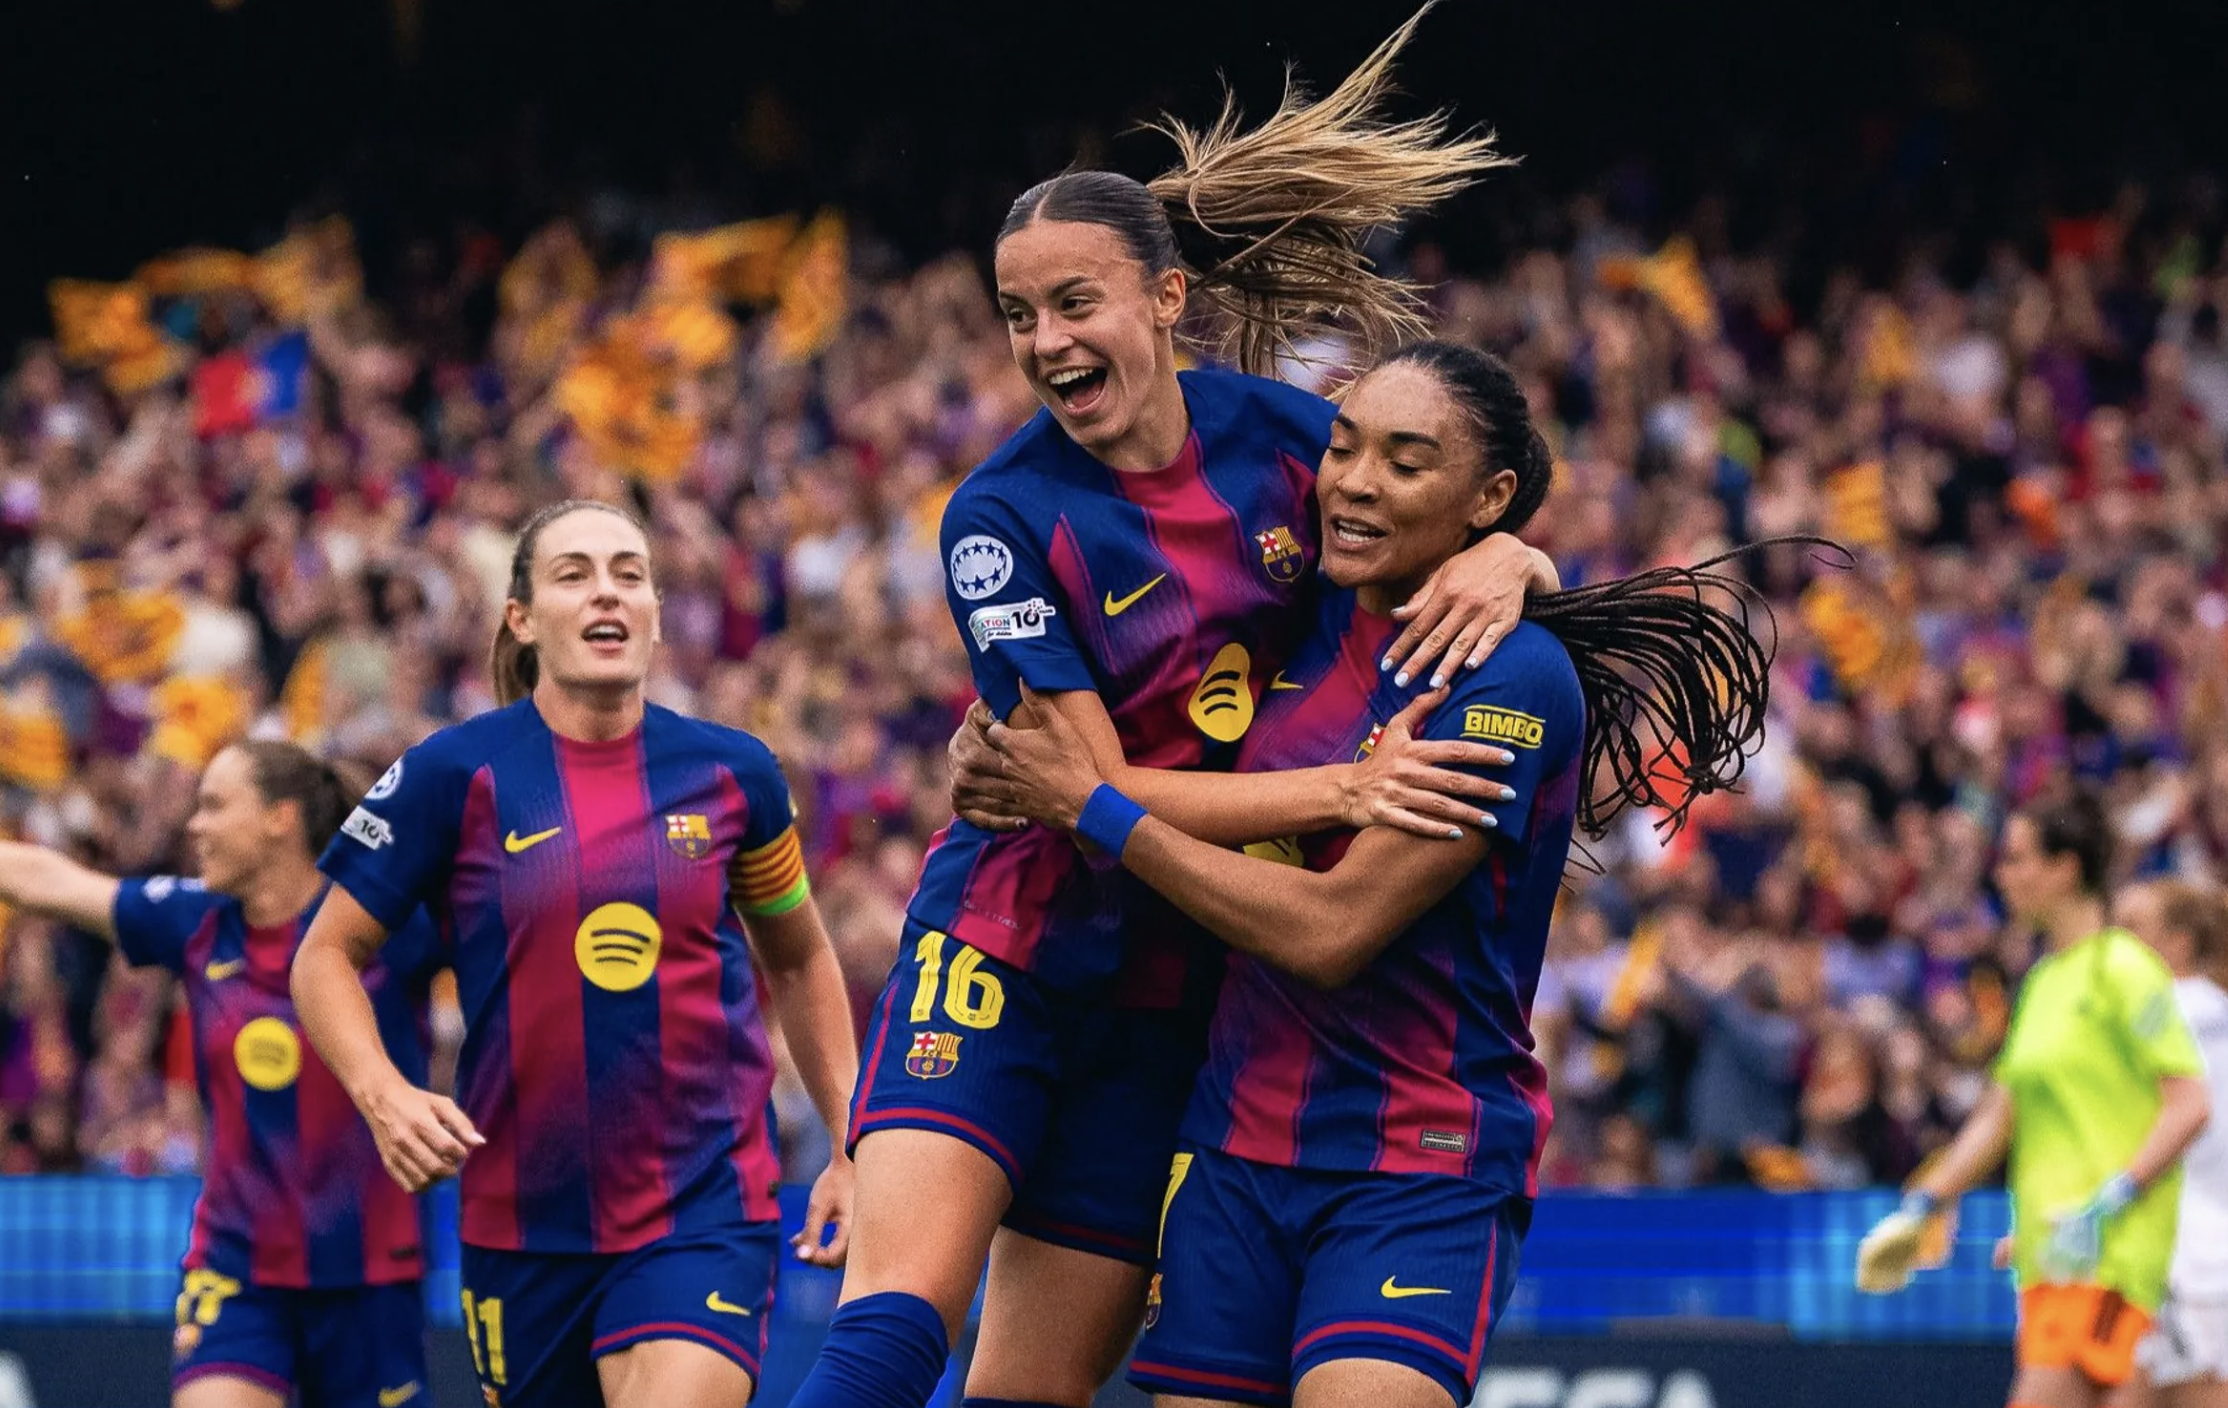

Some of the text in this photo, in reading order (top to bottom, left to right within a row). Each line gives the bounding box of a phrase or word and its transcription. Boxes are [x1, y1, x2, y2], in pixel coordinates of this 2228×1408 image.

[1012, 607, 1041, 629] 10
[1465, 711, 1543, 744] BIMBO
[910, 930, 1005, 1030] 16
[461, 1288, 507, 1385] 11
